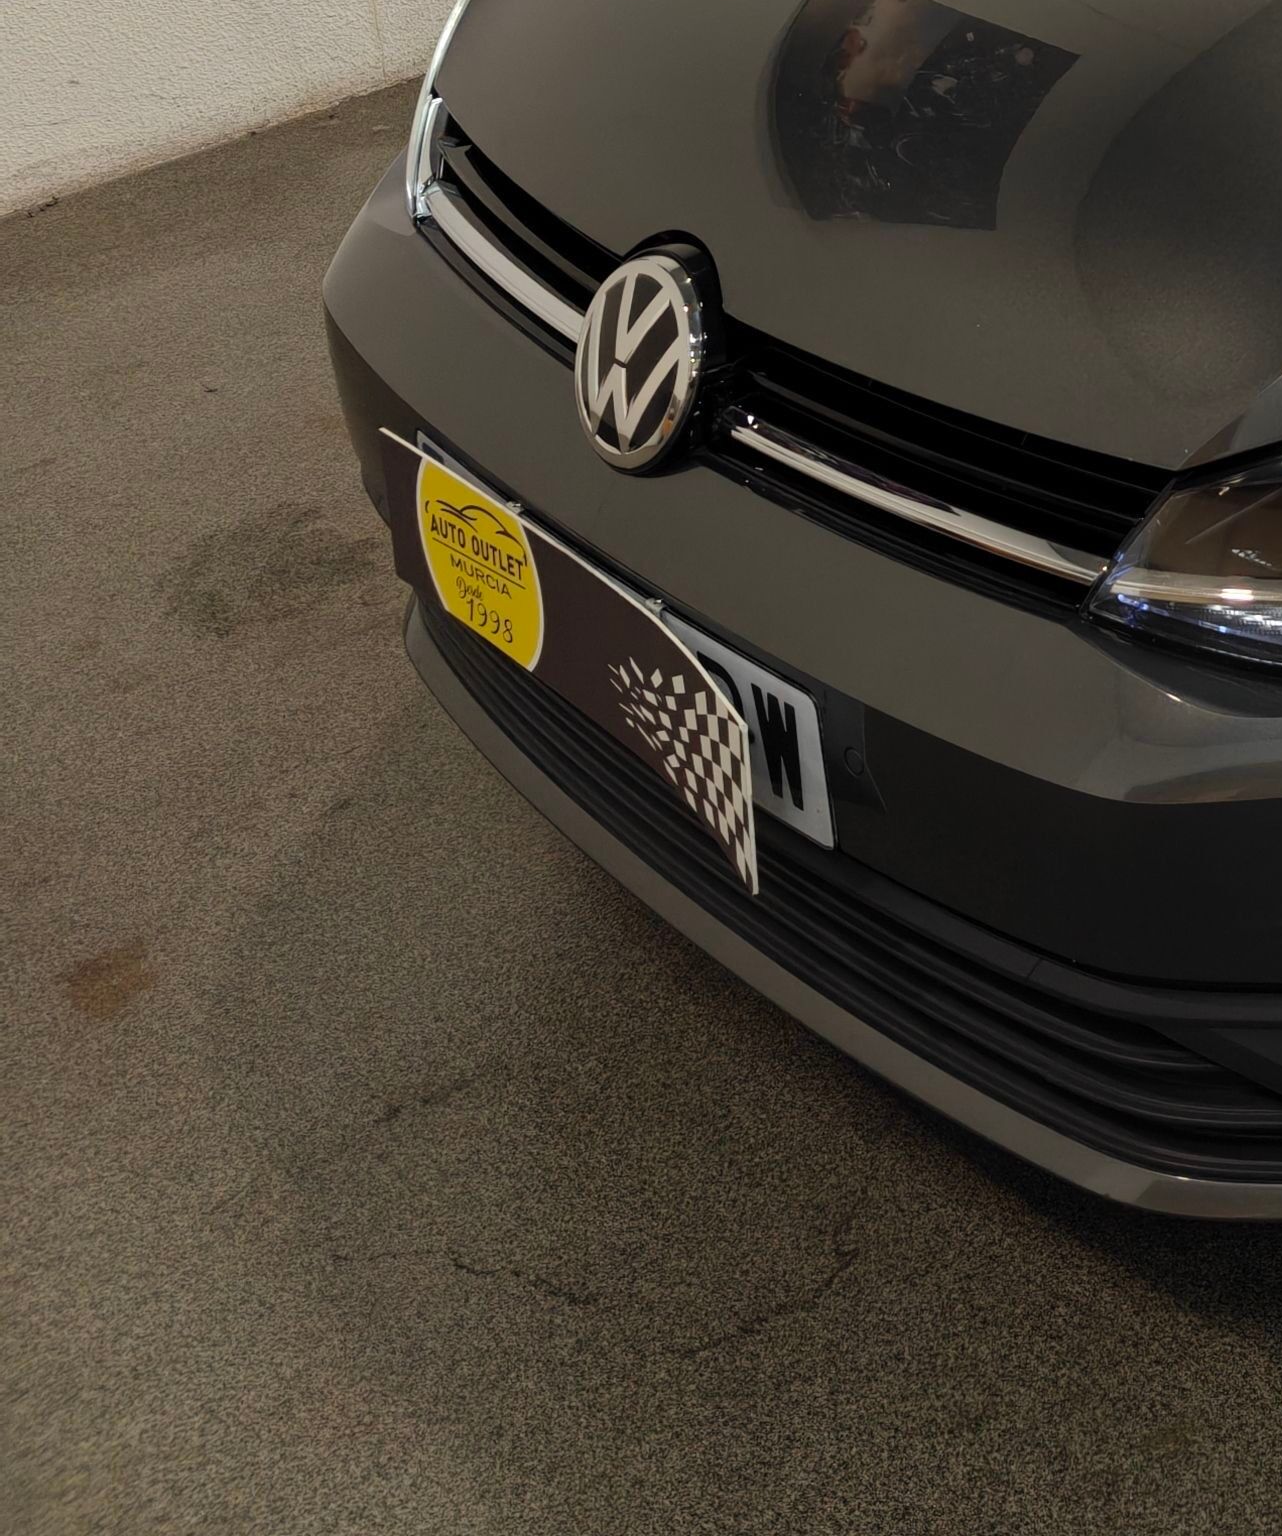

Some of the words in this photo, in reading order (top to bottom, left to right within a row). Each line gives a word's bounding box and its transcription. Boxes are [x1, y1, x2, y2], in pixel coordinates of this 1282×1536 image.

[430, 514, 467, 549] AUTO
[471, 535, 523, 581] OUTLET
[450, 553, 513, 600] MURCIA
[466, 599, 513, 644] 1998
